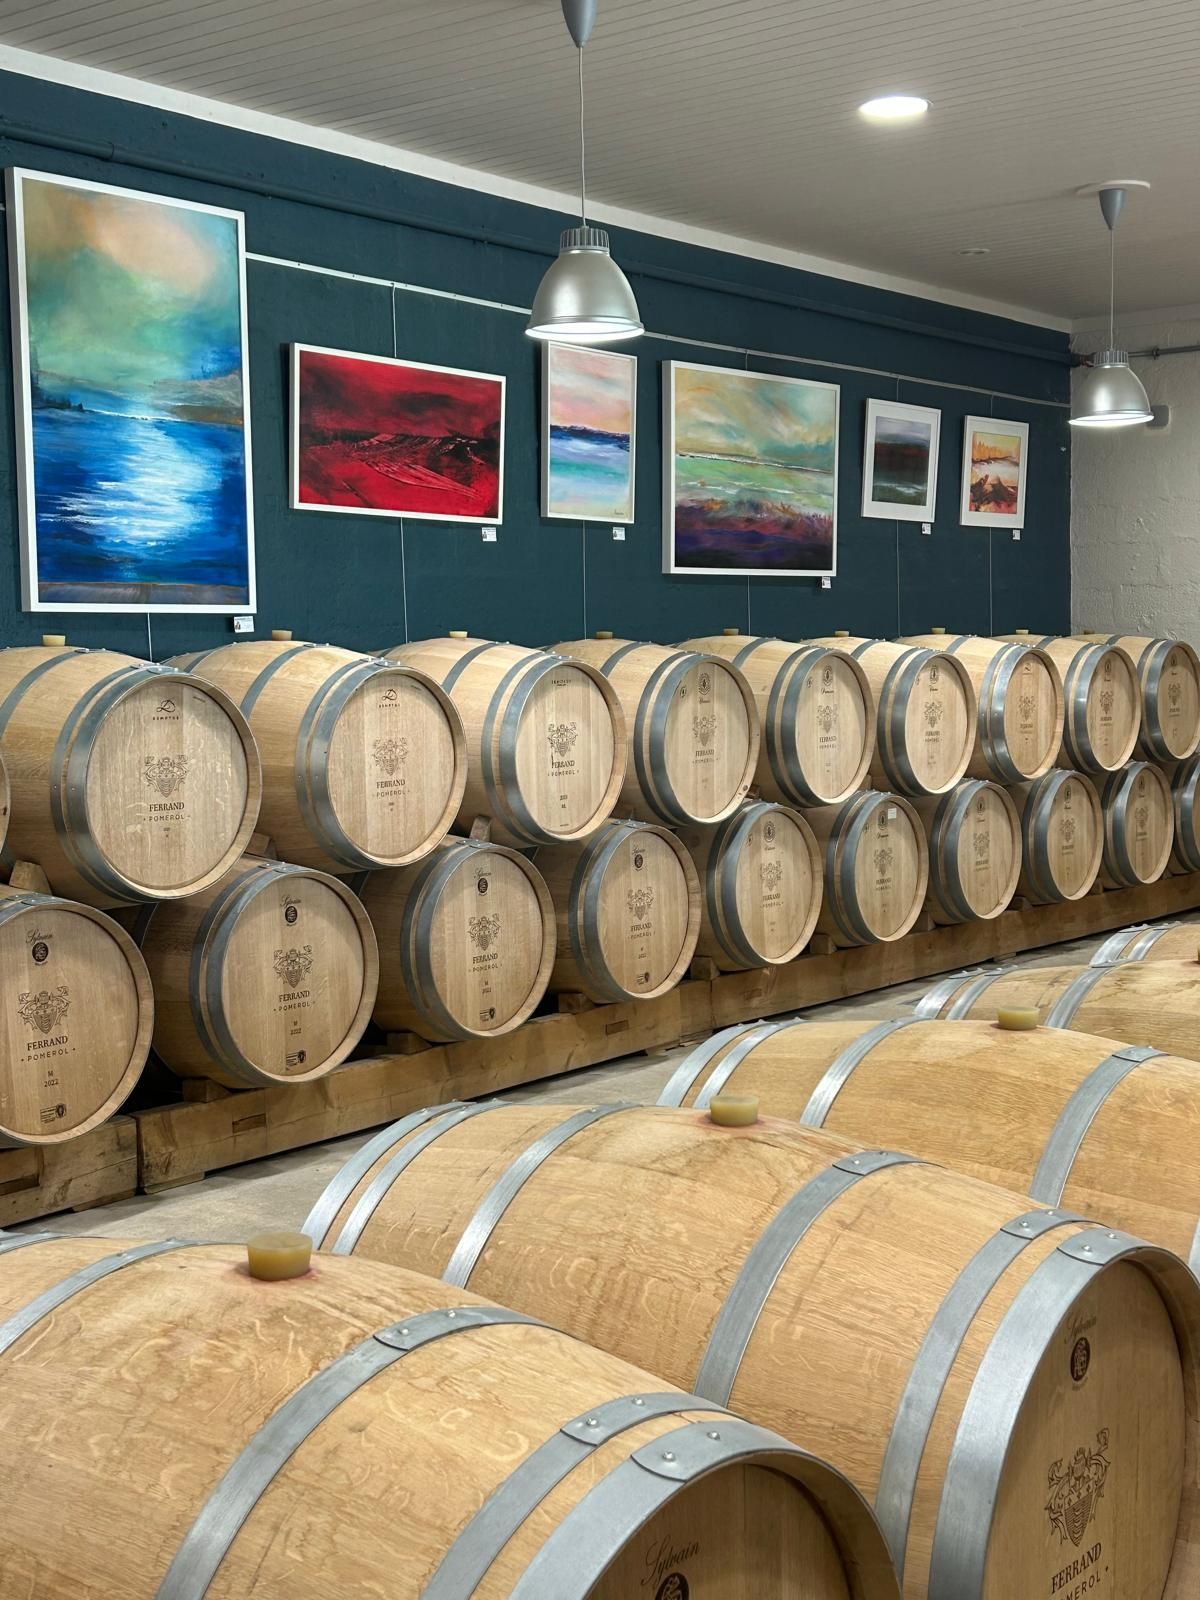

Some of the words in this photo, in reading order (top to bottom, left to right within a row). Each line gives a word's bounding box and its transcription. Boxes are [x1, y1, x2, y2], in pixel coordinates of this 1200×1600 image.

[376, 780, 406, 789] FERRAND
[149, 801, 185, 812] FERRAND
[149, 814, 185, 823] POMEROL
[472, 952, 499, 964] FERRAND
[279, 990, 311, 1003] FERRAND
[278, 1000, 311, 1012] POMEROL
[27, 1036, 69, 1052] FERRAND
[27, 1049, 70, 1062] POMEROL
[640, 1534, 700, 1590] Sylvain
[1051, 1542, 1102, 1595] FERRAND
[1061, 1570, 1101, 1600] MEROL
